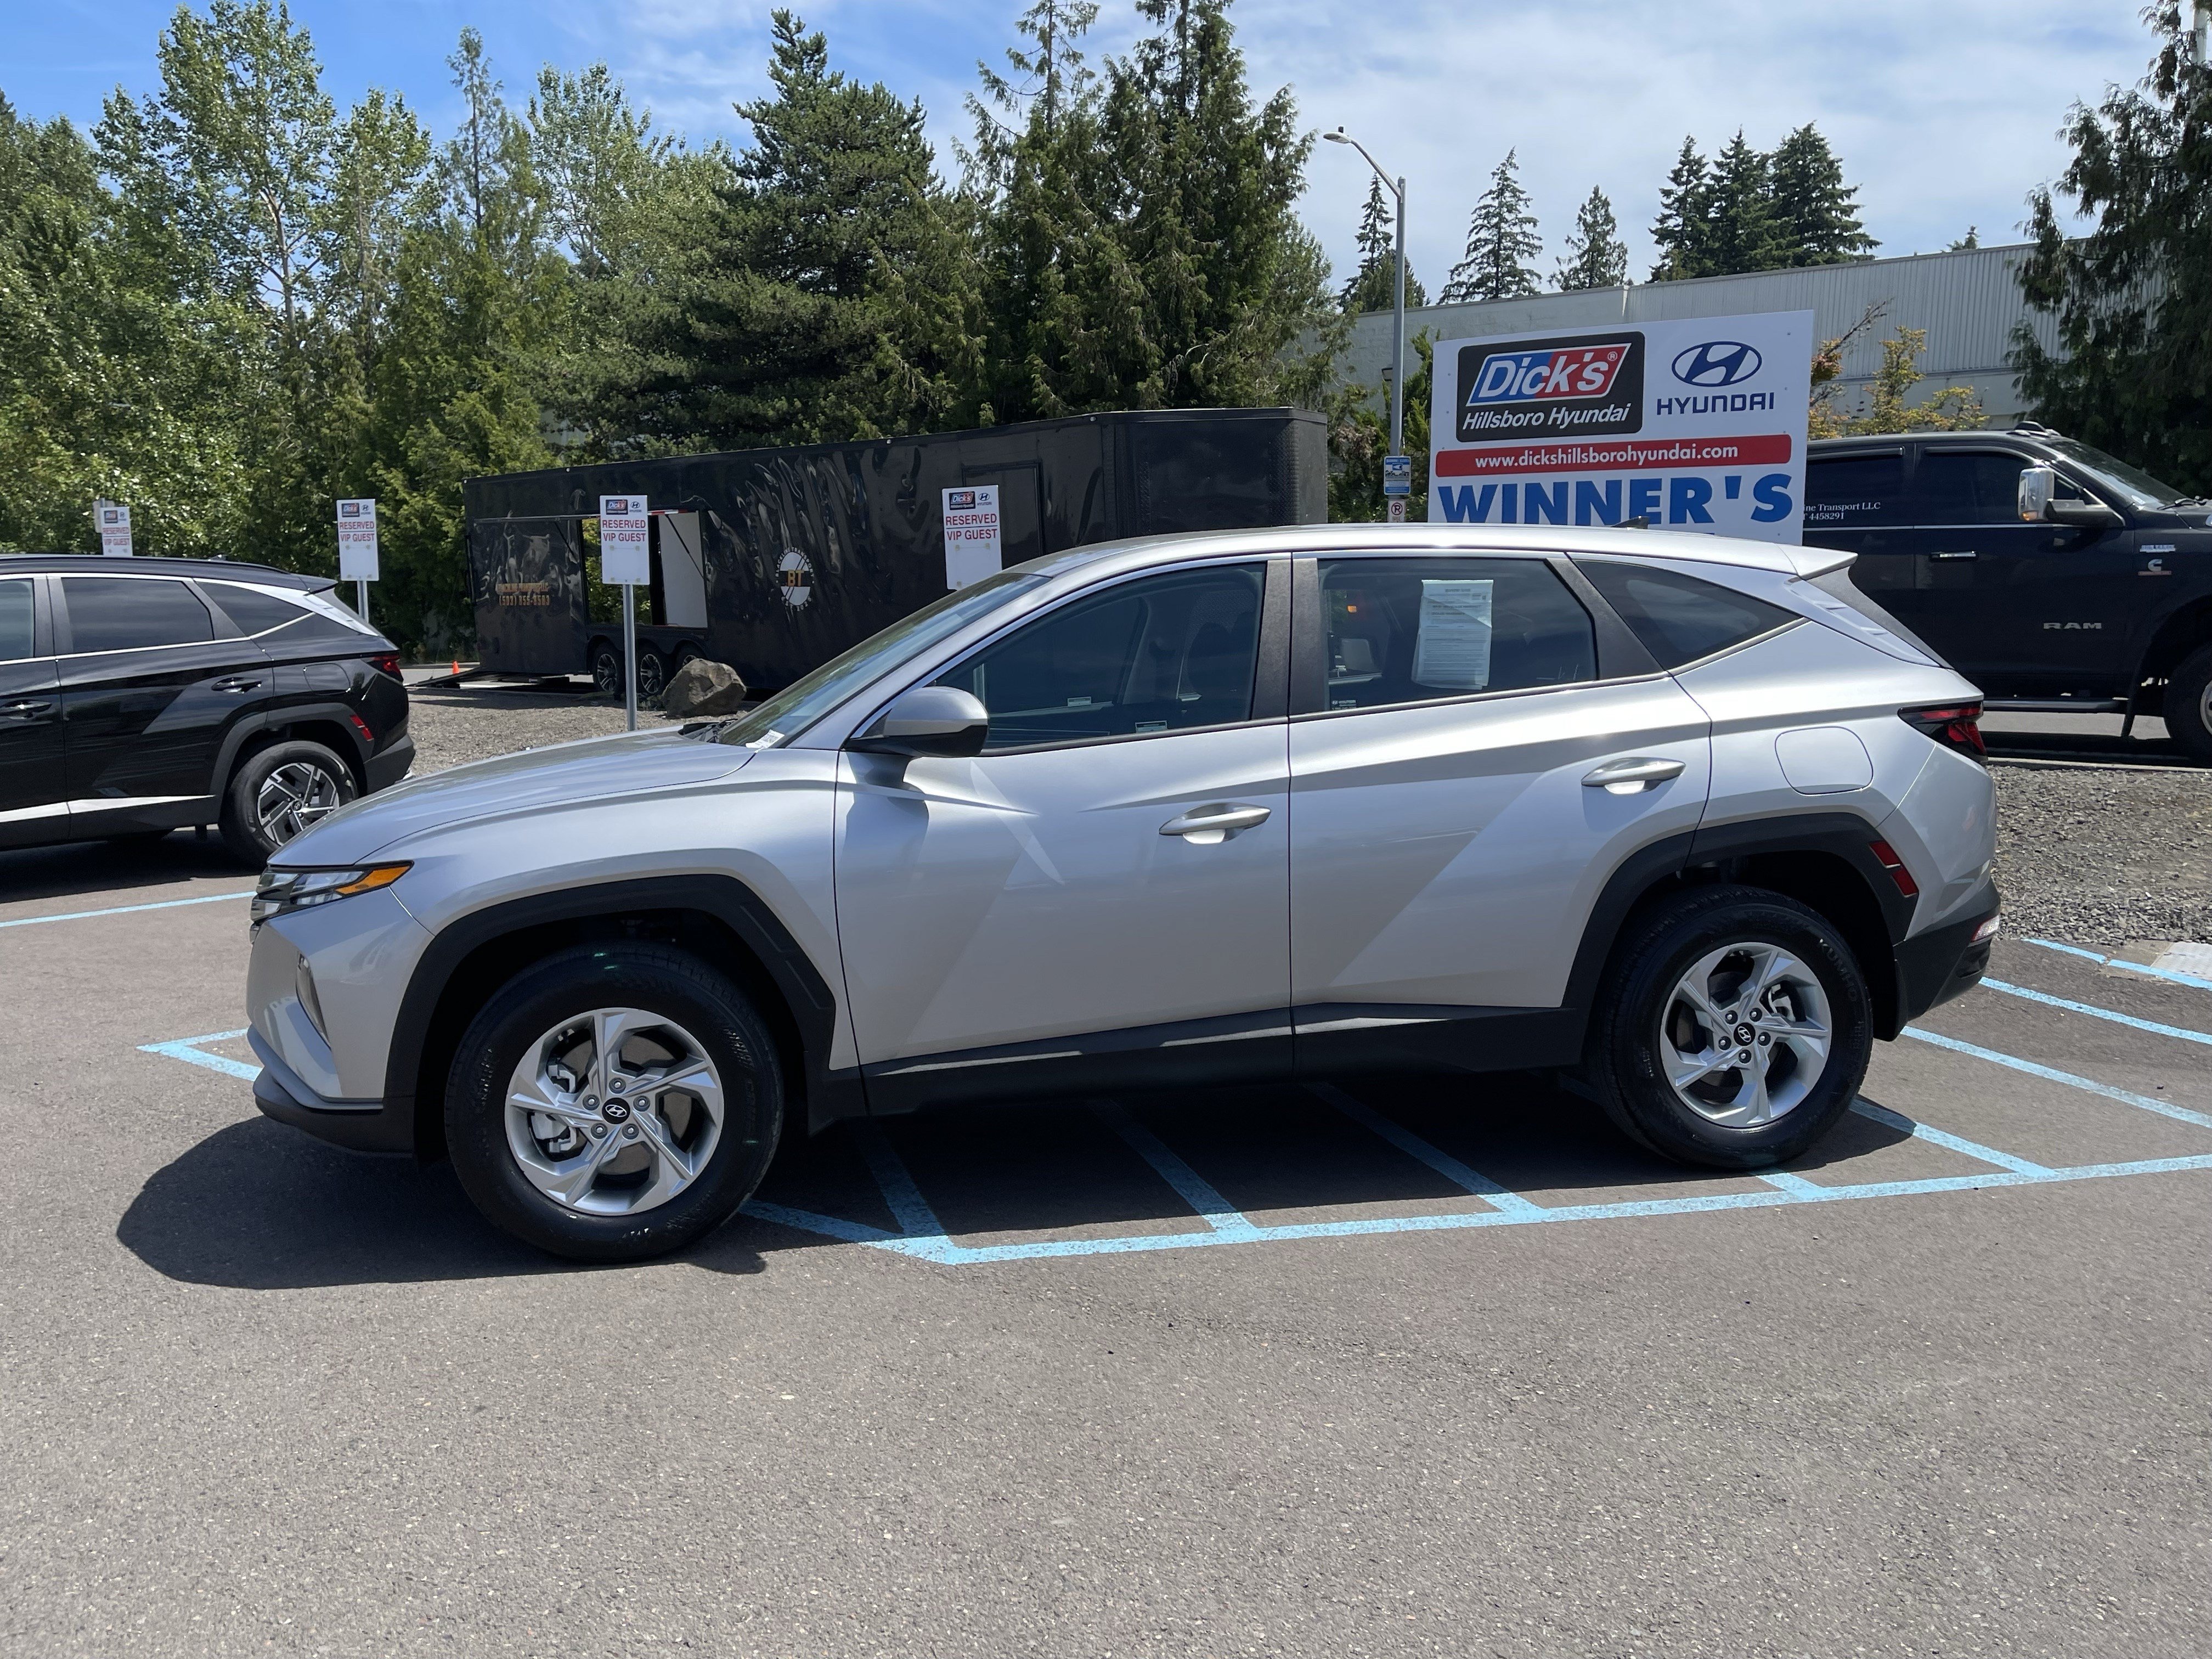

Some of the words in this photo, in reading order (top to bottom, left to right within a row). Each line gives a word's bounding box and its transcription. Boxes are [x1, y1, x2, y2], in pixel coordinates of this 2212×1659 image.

[1477, 352, 1609, 398] Dick's
[1656, 392, 1774, 415] HYUNDAI
[1462, 410, 1545, 431] Hillsboro
[1547, 403, 1632, 426] Hyundai
[1475, 443, 1739, 469] www.dickshillsborohyundai.com
[1437, 473, 1792, 525] WINNER'S
[1818, 503, 1860, 512] Transport
[1862, 502, 1881, 510] LLC
[945, 514, 997, 526] RESERVED
[1809, 512, 1844, 521] 4458291
[339, 521, 375, 530] RESERVED
[602, 520, 646, 528] RESERVED
[340, 534, 351, 542] VIP
[353, 533, 375, 541] GUEST
[603, 533, 616, 541] VIP
[618, 533, 646, 541] GUEST
[947, 531, 962, 540] VIP
[965, 529, 997, 540] GUEST
[787, 569, 804, 586] BT
